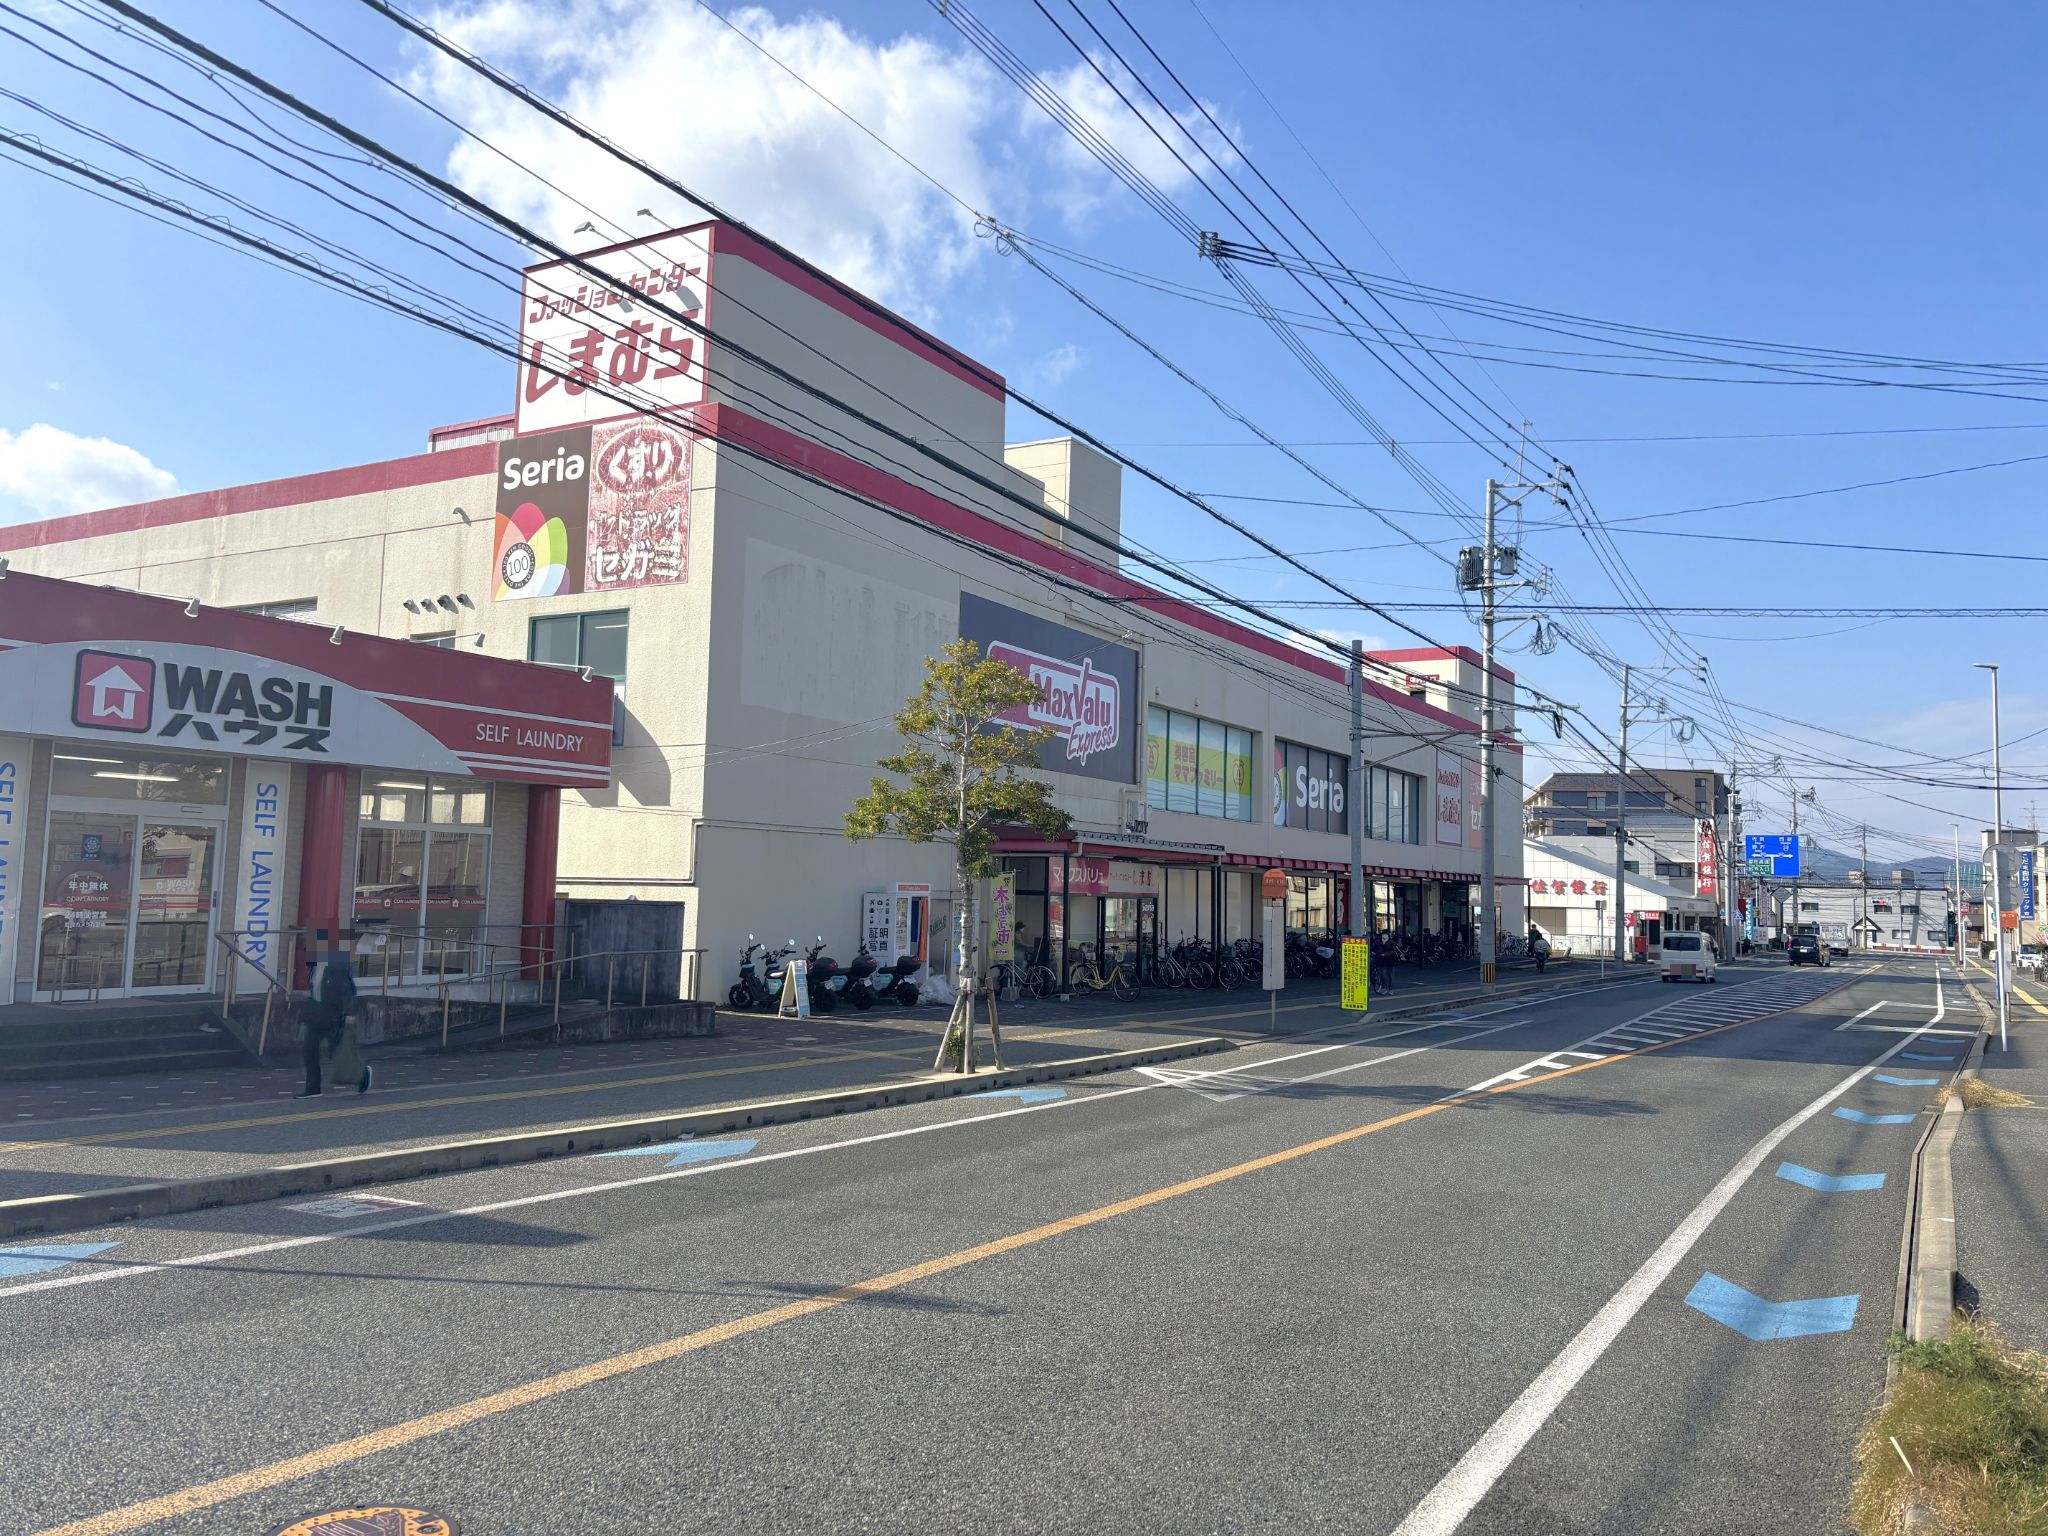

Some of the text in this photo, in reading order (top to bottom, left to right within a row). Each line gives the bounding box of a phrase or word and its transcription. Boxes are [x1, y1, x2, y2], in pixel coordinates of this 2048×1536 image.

[525, 308, 699, 403] しまむら
[503, 446, 585, 490] Seria
[608, 437, 673, 484] くすり
[508, 556, 529, 576] 100
[163, 662, 333, 728] WASH
[1033, 661, 1111, 727] MaxValu
[157, 713, 331, 753] ハウス
[476, 723, 584, 752] SELF LAUNDRY
[1067, 720, 1113, 761] Express
[1295, 765, 1344, 814] Seria
[68, 881, 109, 891] 年中無休
[166, 880, 196, 889] WASH
[245, 782, 278, 970] SELF LAUNDRY
[1530, 879, 1608, 896] 佐賀銀行
[1141, 902, 1155, 912] Seria
[868, 927, 889, 940] 証明
[868, 940, 889, 952] 写真
